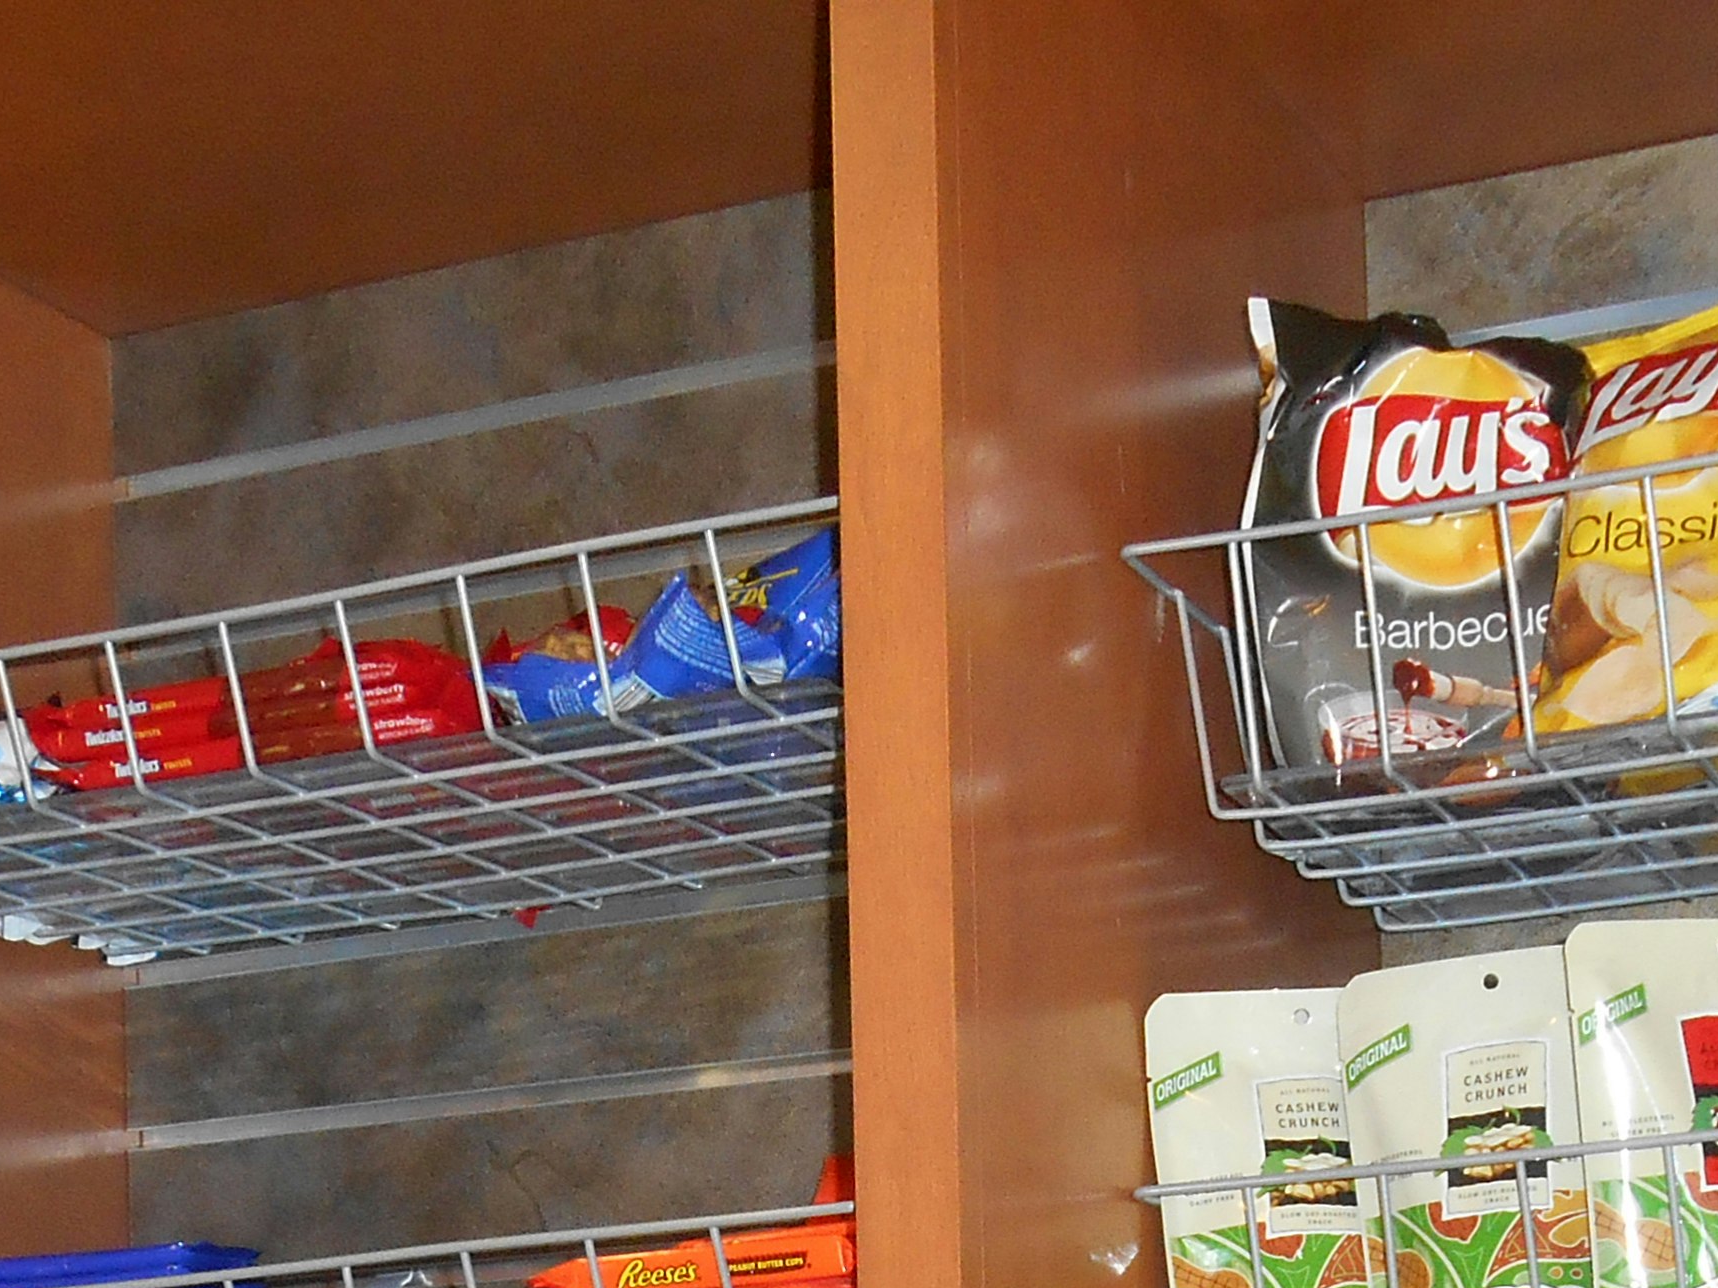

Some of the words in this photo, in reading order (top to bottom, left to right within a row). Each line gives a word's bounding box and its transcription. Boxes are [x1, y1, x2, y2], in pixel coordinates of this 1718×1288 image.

[1336, 396, 1552, 526] Lay's
[1353, 601, 1550, 652] Barbecue
[1346, 1031, 1411, 1086] ORIGINAL
[1152, 1058, 1219, 1104] ORIGINAL
[1463, 1066, 1529, 1087] CASHEW
[1464, 1081, 1529, 1103] CRUNCH
[1274, 1100, 1342, 1114] CASHEW
[1277, 1114, 1342, 1129] CRUNCH
